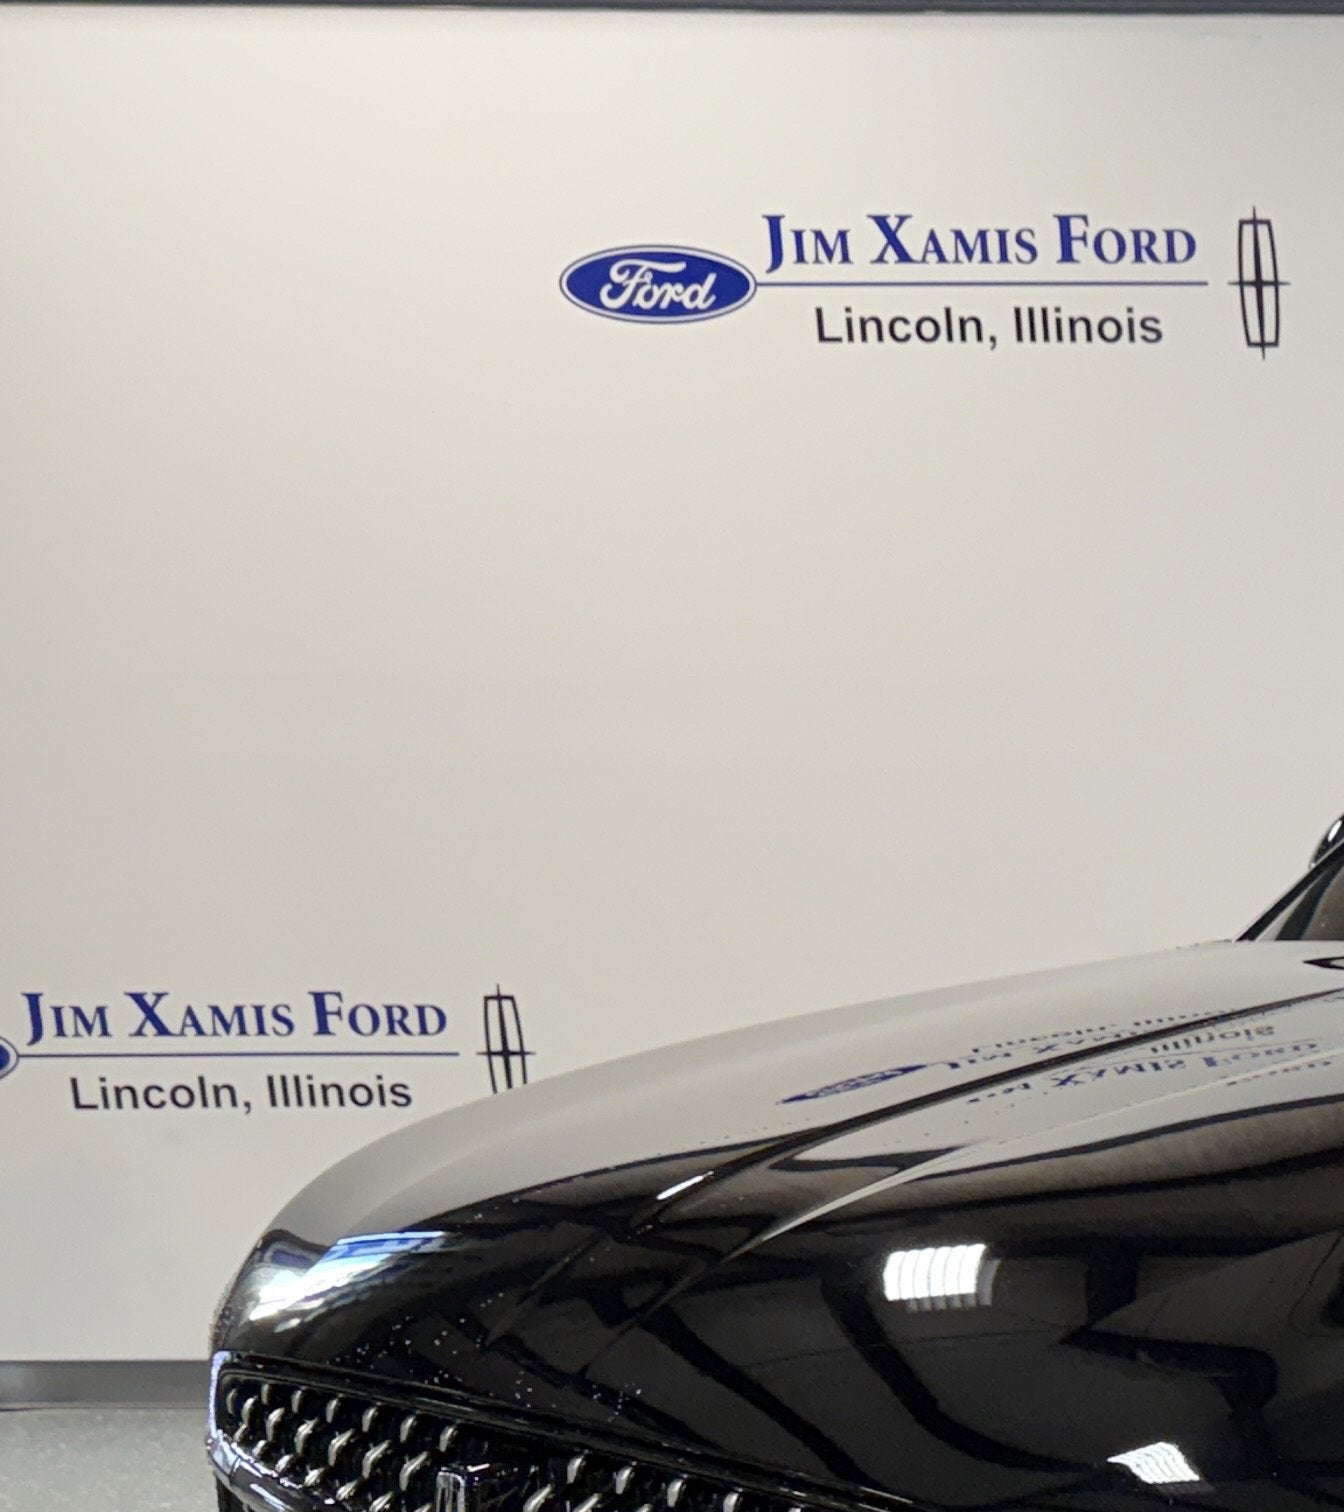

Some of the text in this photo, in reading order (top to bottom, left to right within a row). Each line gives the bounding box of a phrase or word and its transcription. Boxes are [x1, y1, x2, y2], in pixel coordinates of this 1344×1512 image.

[761, 213, 1198, 275] JIM XAMIS FORD
[600, 258, 716, 310] Ford
[815, 305, 1164, 351] Lincoln, Illinois
[20, 990, 448, 1048] JIM XAMIS FORD
[69, 1073, 413, 1116] Lincoln, Illinois
